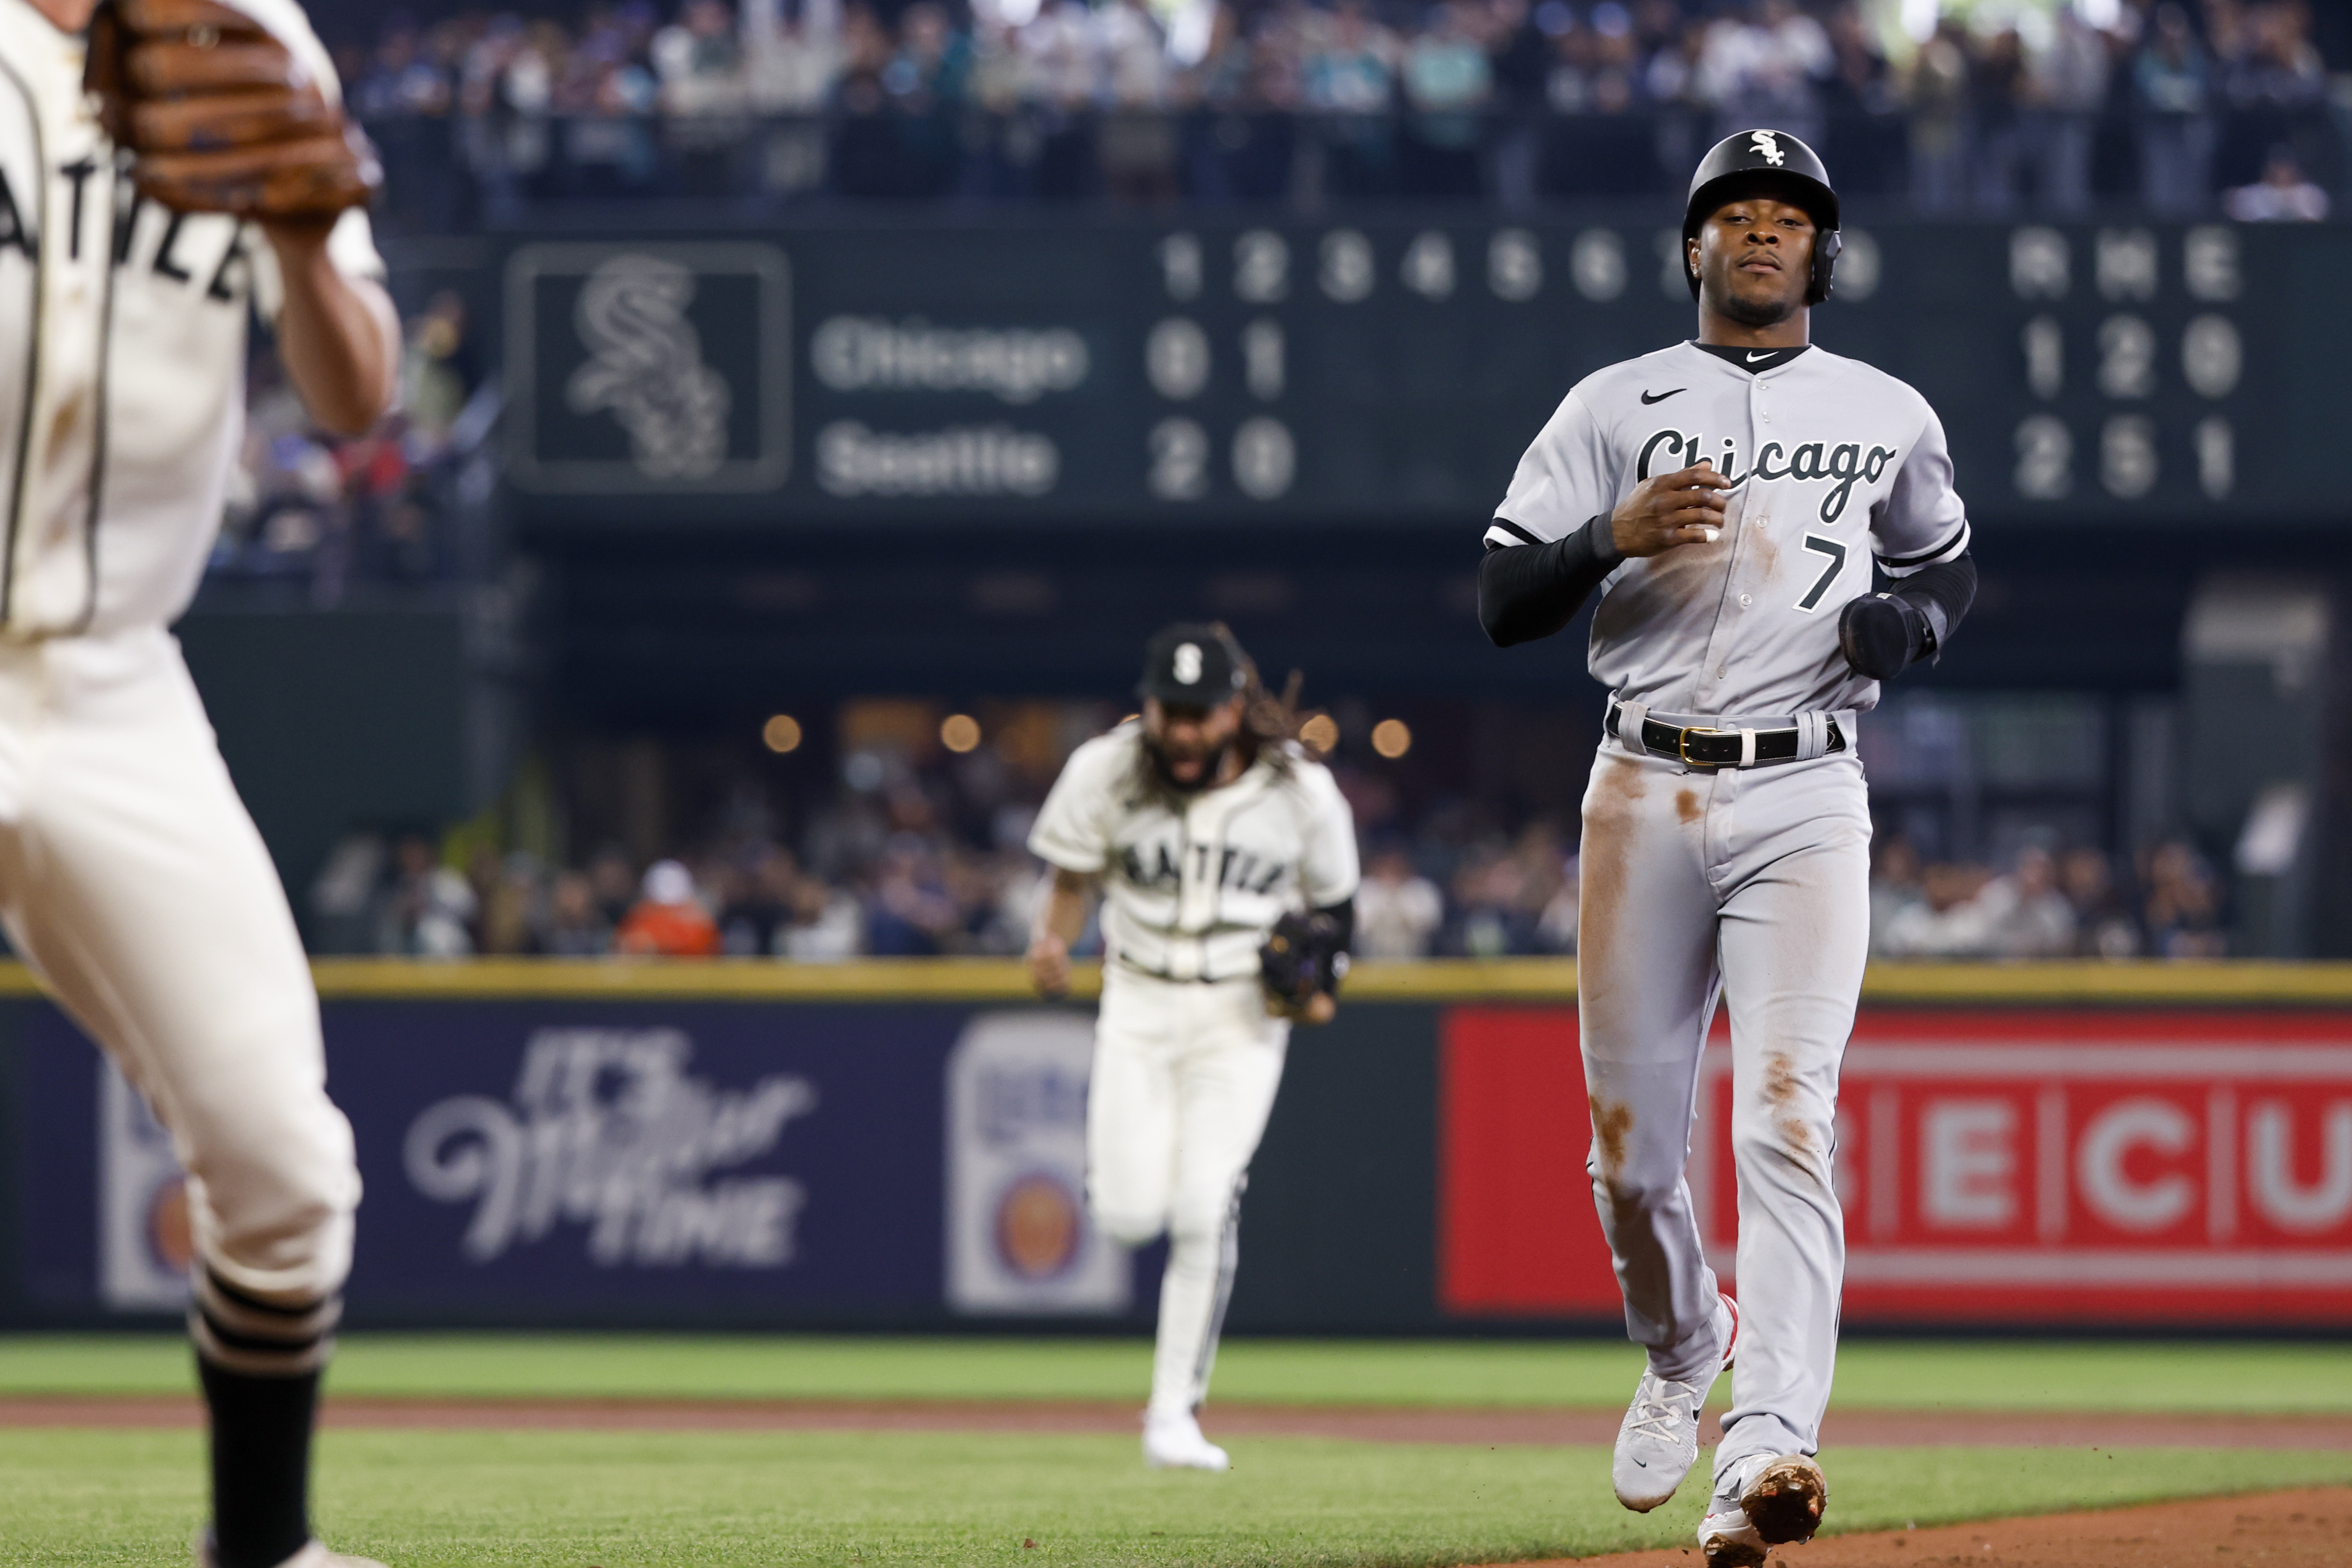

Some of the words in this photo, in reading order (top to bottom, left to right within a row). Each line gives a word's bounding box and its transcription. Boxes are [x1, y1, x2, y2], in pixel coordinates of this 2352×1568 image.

[1162, 234, 1202, 301] 1
[1233, 232, 1288, 304] 2
[1319, 232, 1375, 304] 3
[1403, 232, 1456, 303] 4
[1487, 232, 1541, 303] 5
[2184, 225, 2242, 303] E
[811, 316, 1088, 404] Chicago
[1146, 318, 1209, 400] 0
[1245, 320, 1284, 400] 1
[2023, 314, 2064, 400] 1
[2097, 313, 2156, 400] 2
[2181, 312, 2242, 400] 0
[815, 421, 1059, 496] Seattle
[1147, 417, 1209, 500] 2
[1232, 417, 1294, 500] 0
[2013, 414, 2074, 499] 2
[2100, 414, 2159, 499] 5
[2194, 415, 2236, 500] 1
[1637, 427, 1899, 527] Chicago
[1792, 531, 1849, 614] 7
[1172, 642, 1204, 685] S
[1832, 1101, 2352, 1230] ECU
[593, 1175, 806, 1267] TIME
